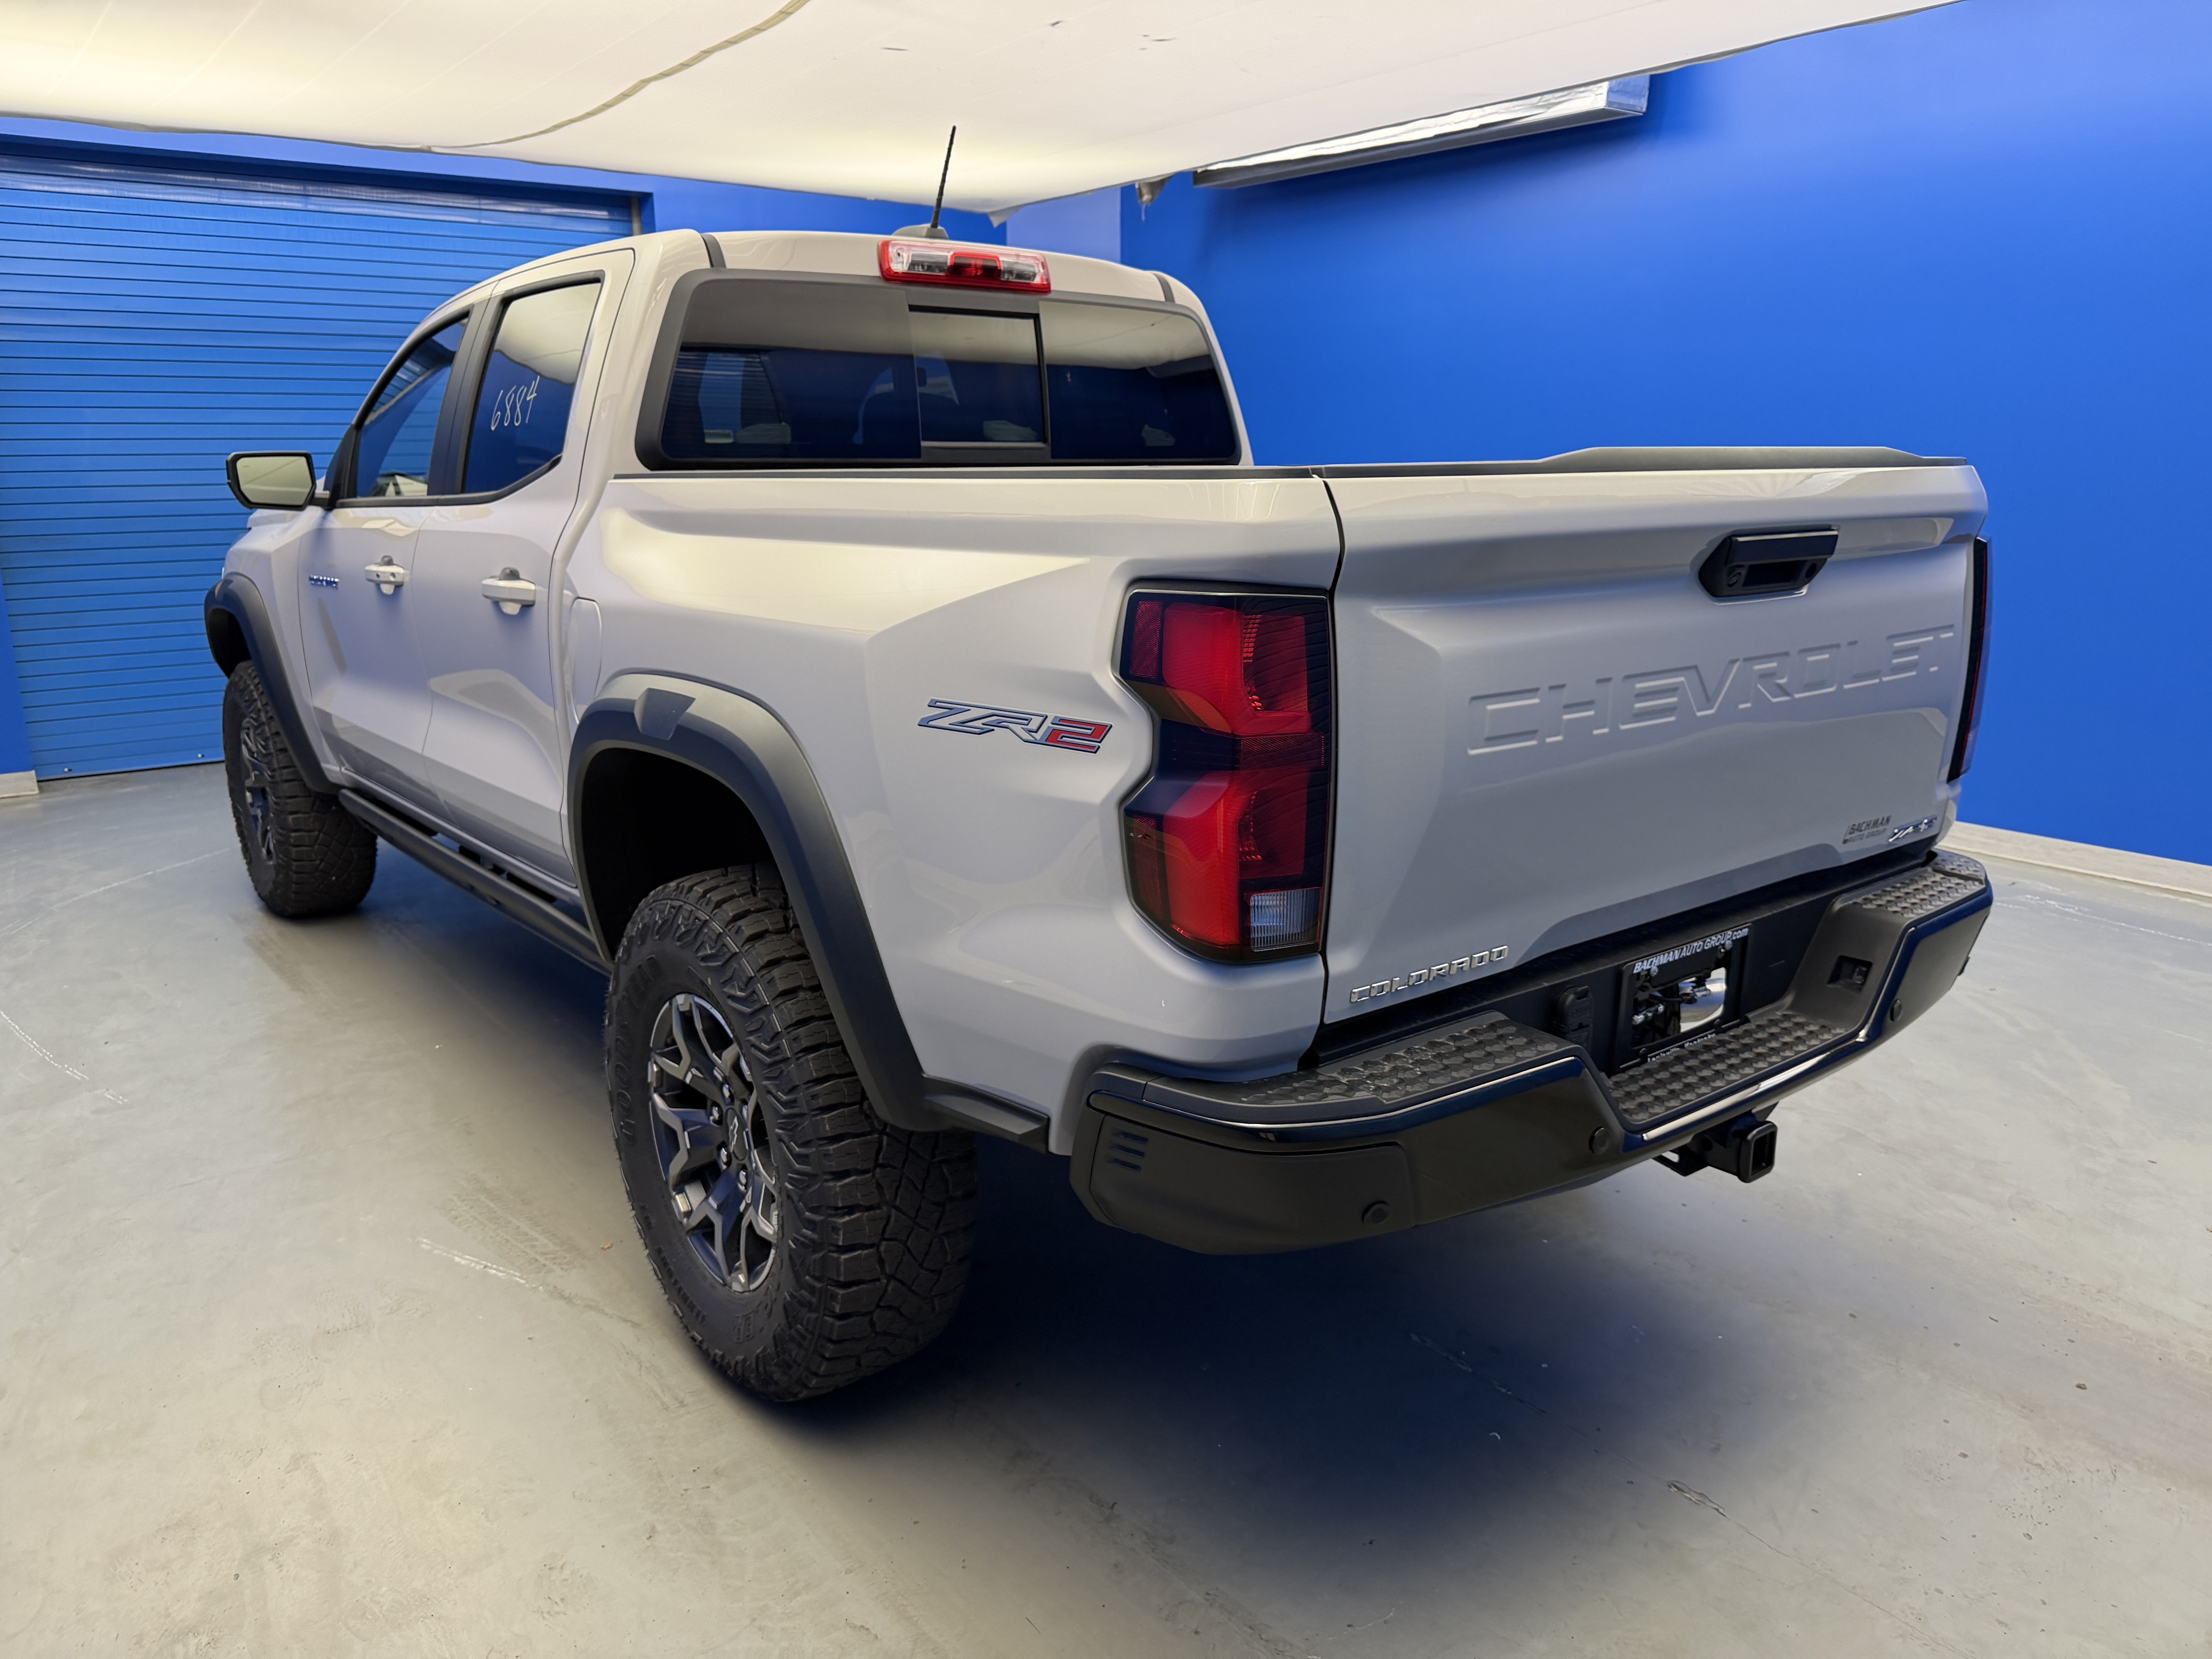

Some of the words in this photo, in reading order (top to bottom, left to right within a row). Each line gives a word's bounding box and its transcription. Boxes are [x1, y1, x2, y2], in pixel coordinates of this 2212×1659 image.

[491, 375, 540, 431] 6884
[1468, 624, 1955, 754] CHEVROLET
[917, 698, 1113, 754] ZR2
[1350, 945, 1508, 1003] COLORADO
[1633, 950, 1682, 974] BACHMAN
[1680, 941, 1704, 958] AUTO
